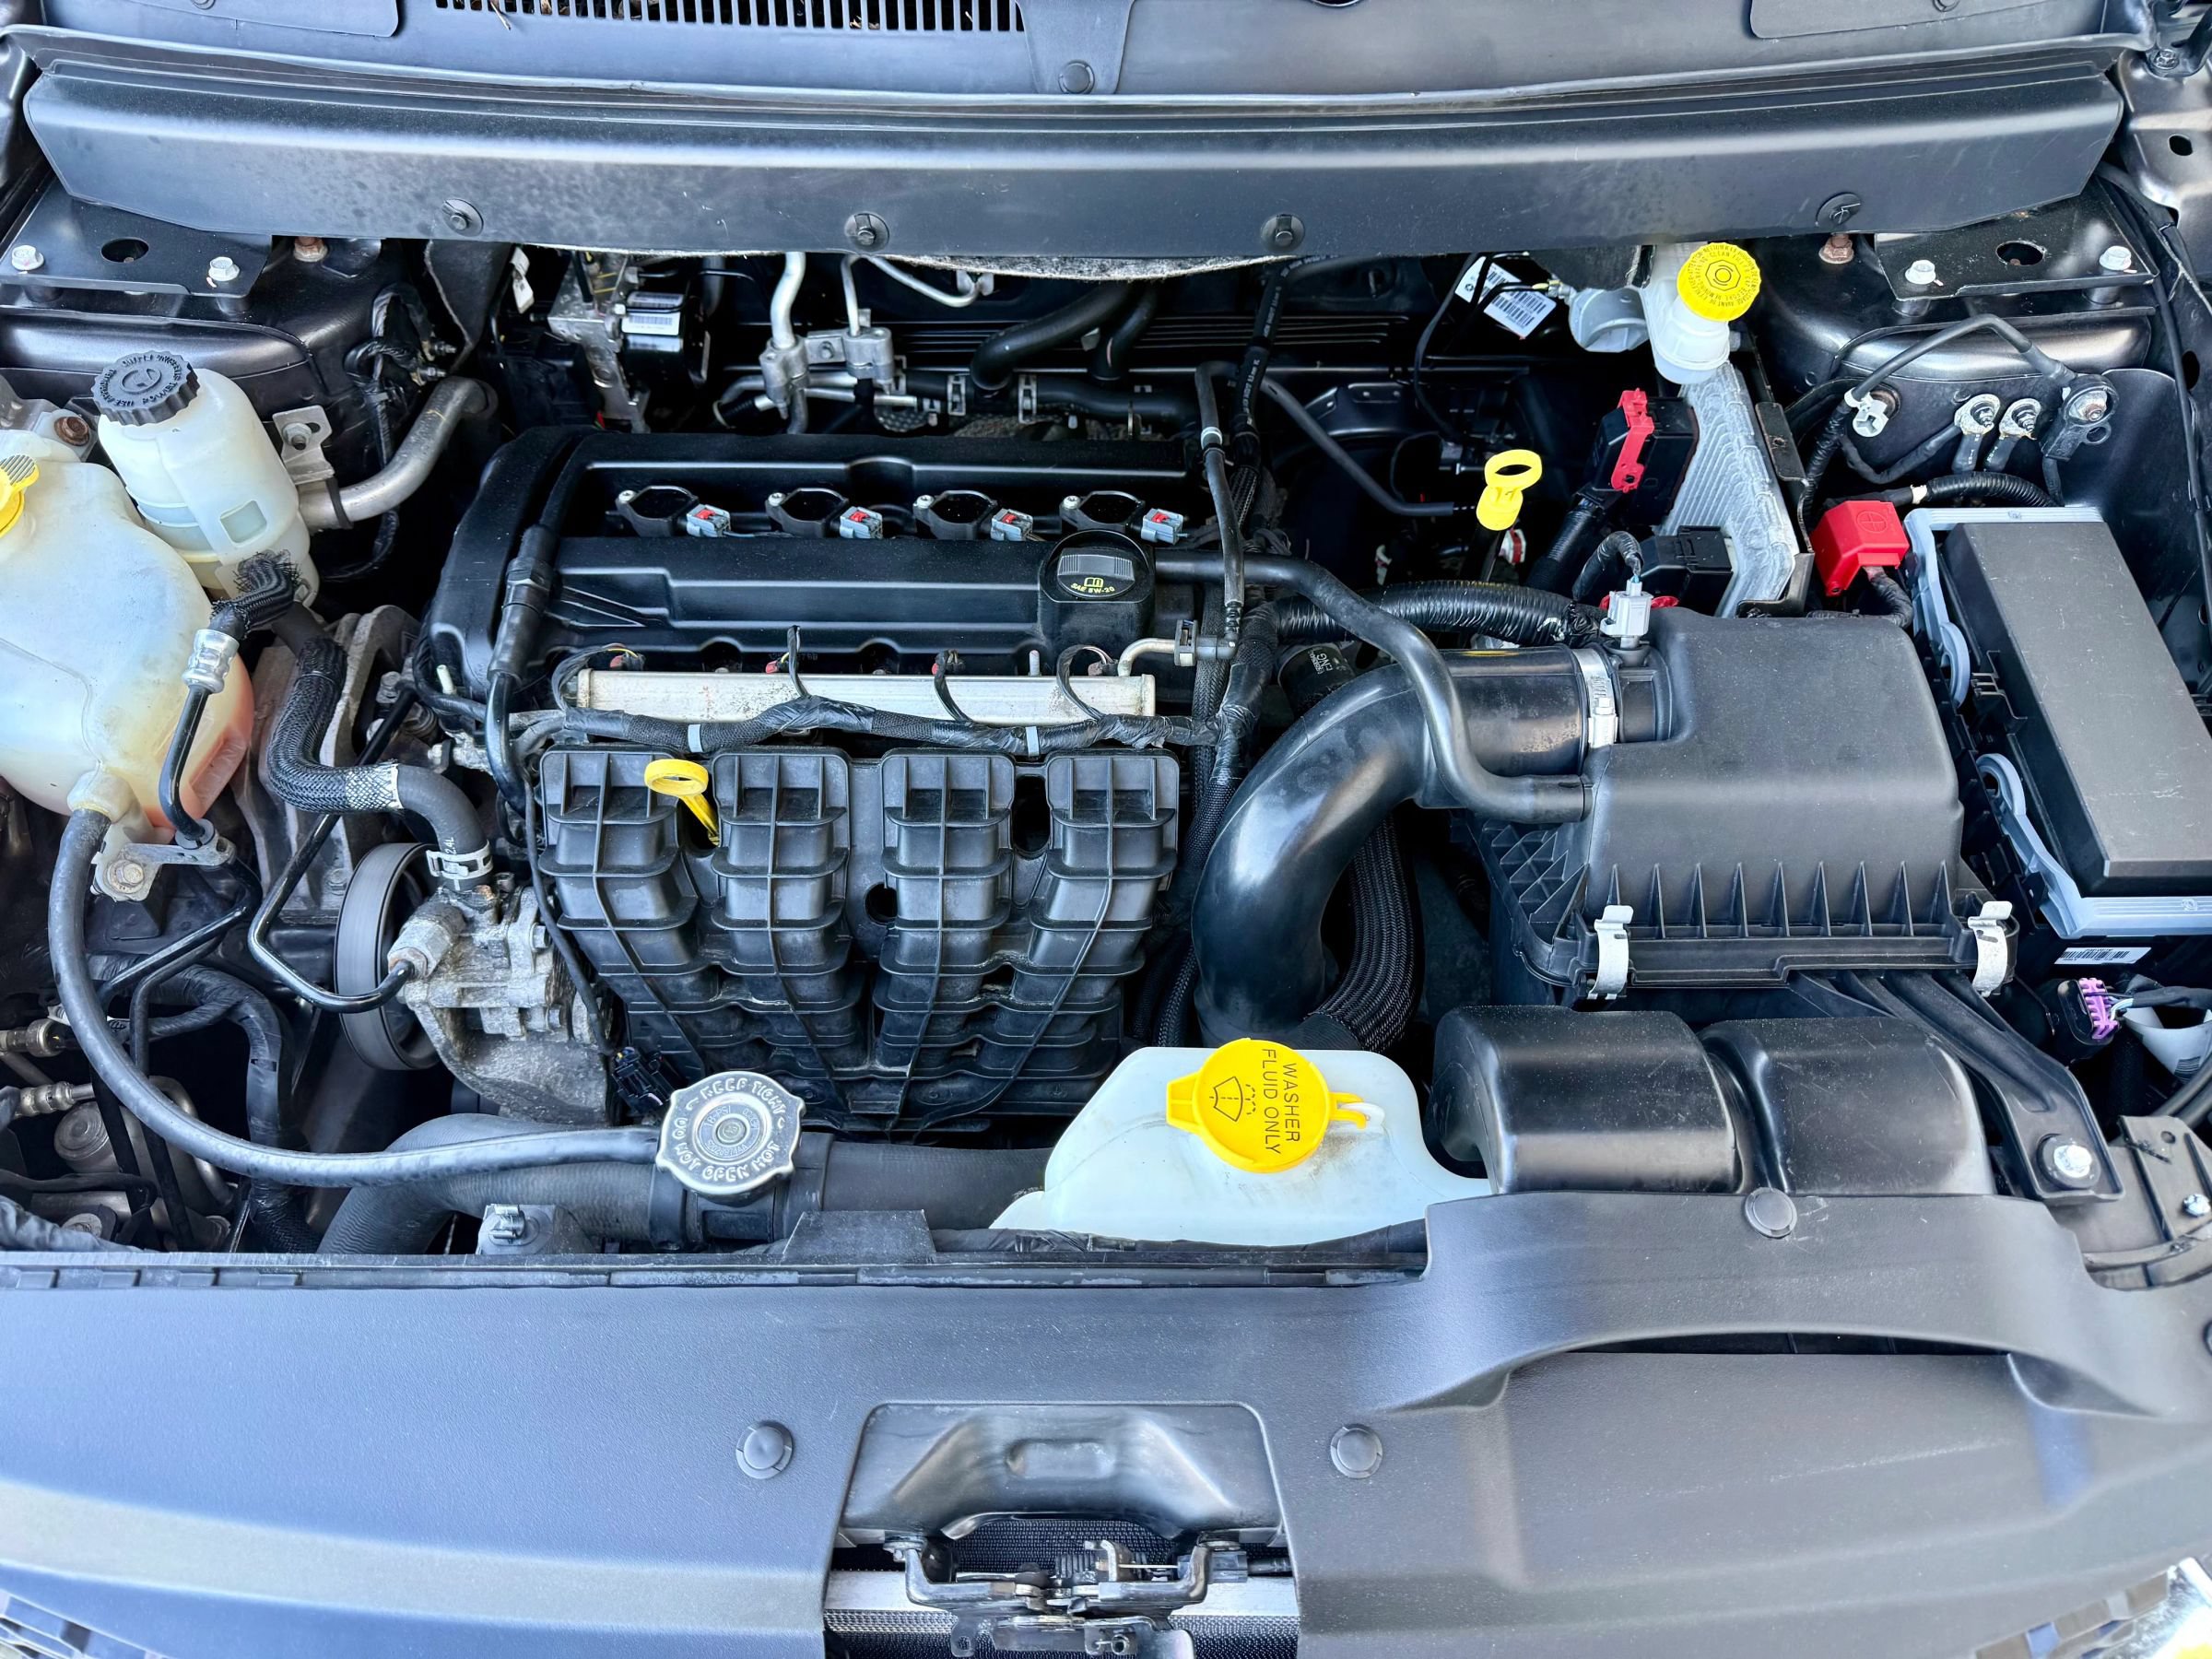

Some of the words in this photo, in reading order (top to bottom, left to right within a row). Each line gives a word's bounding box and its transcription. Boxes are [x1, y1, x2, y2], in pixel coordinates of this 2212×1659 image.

[1070, 582, 1088, 593] SAE
[442, 837, 457, 854] 2.4L
[1262, 1048, 1278, 1100] FLUID
[1282, 1062, 1300, 1142] WASHER
[1264, 1107, 1281, 1154] ONLY
[701, 1163, 750, 1182] OPEN
